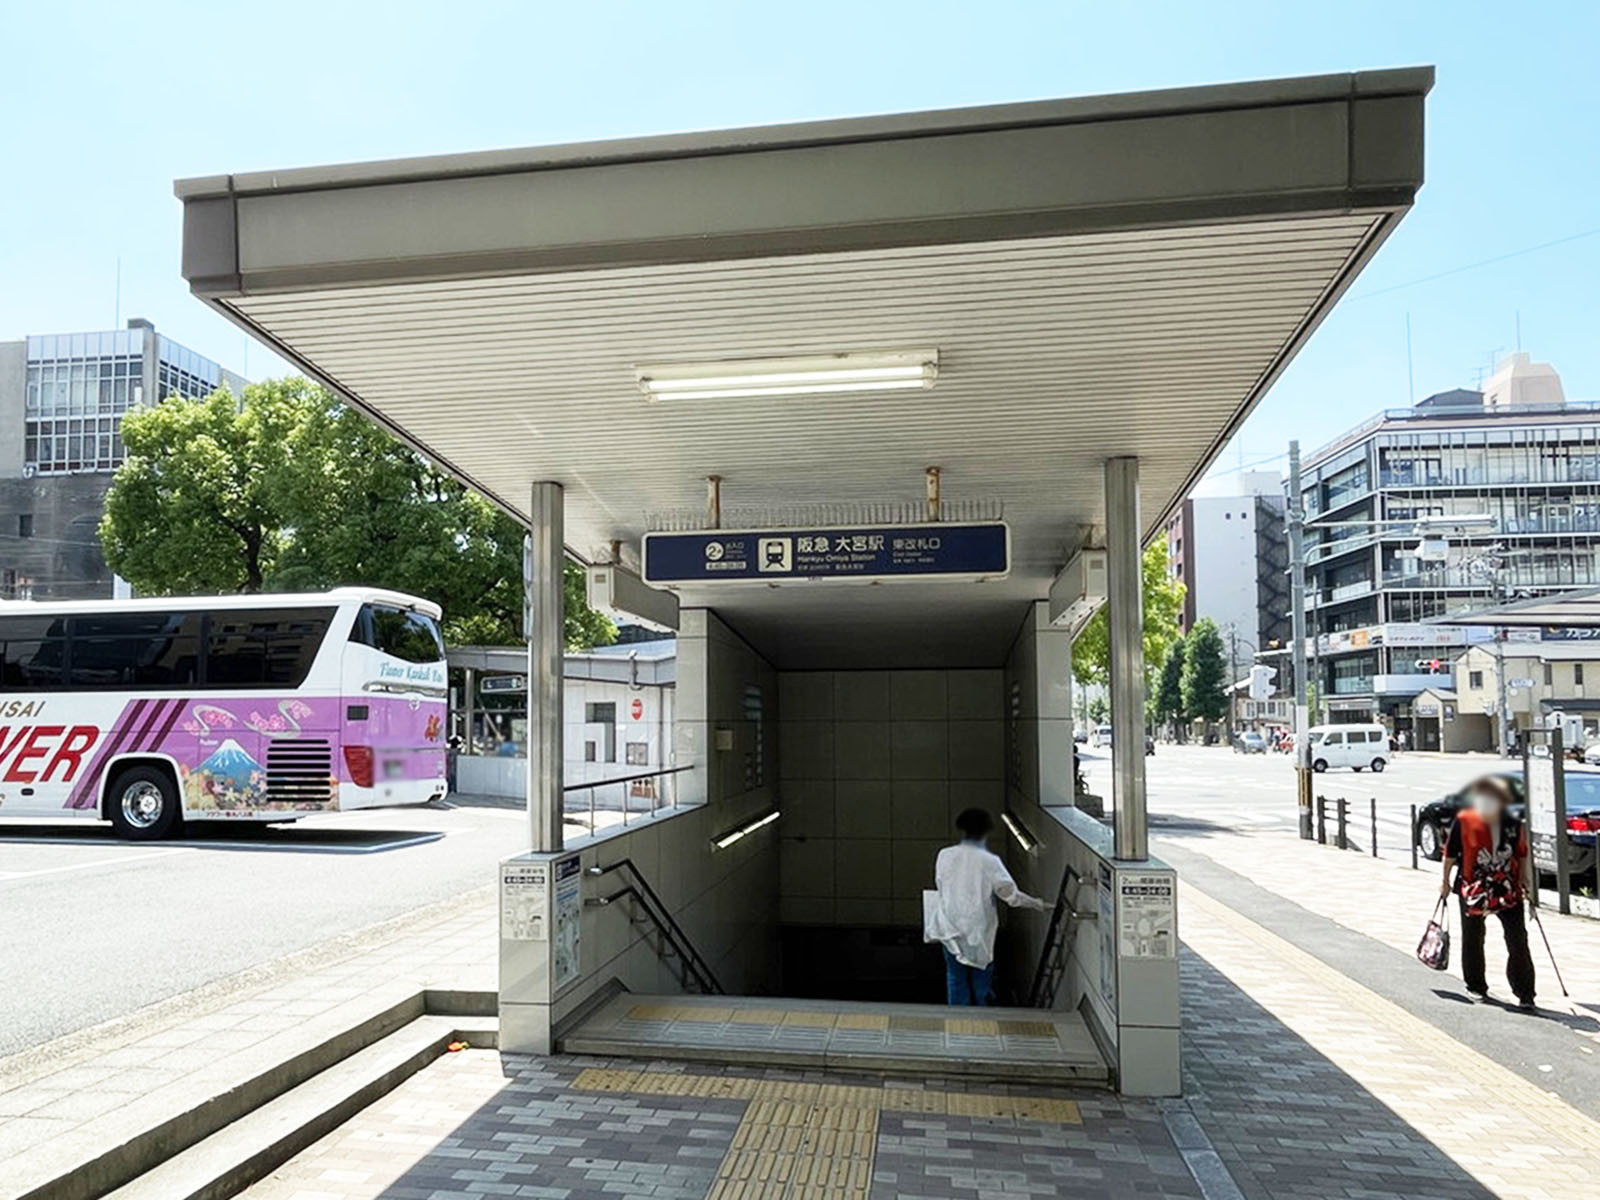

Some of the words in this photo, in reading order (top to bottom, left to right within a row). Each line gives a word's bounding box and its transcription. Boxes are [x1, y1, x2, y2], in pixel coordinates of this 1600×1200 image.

[797, 536, 830, 553] 阪急
[835, 534, 885, 552] 大宮駅
[893, 537, 941, 550] 東改札口
[797, 555, 825, 564] Hankyu
[826, 554, 849, 563] Omiya
[851, 553, 876, 562] Station
